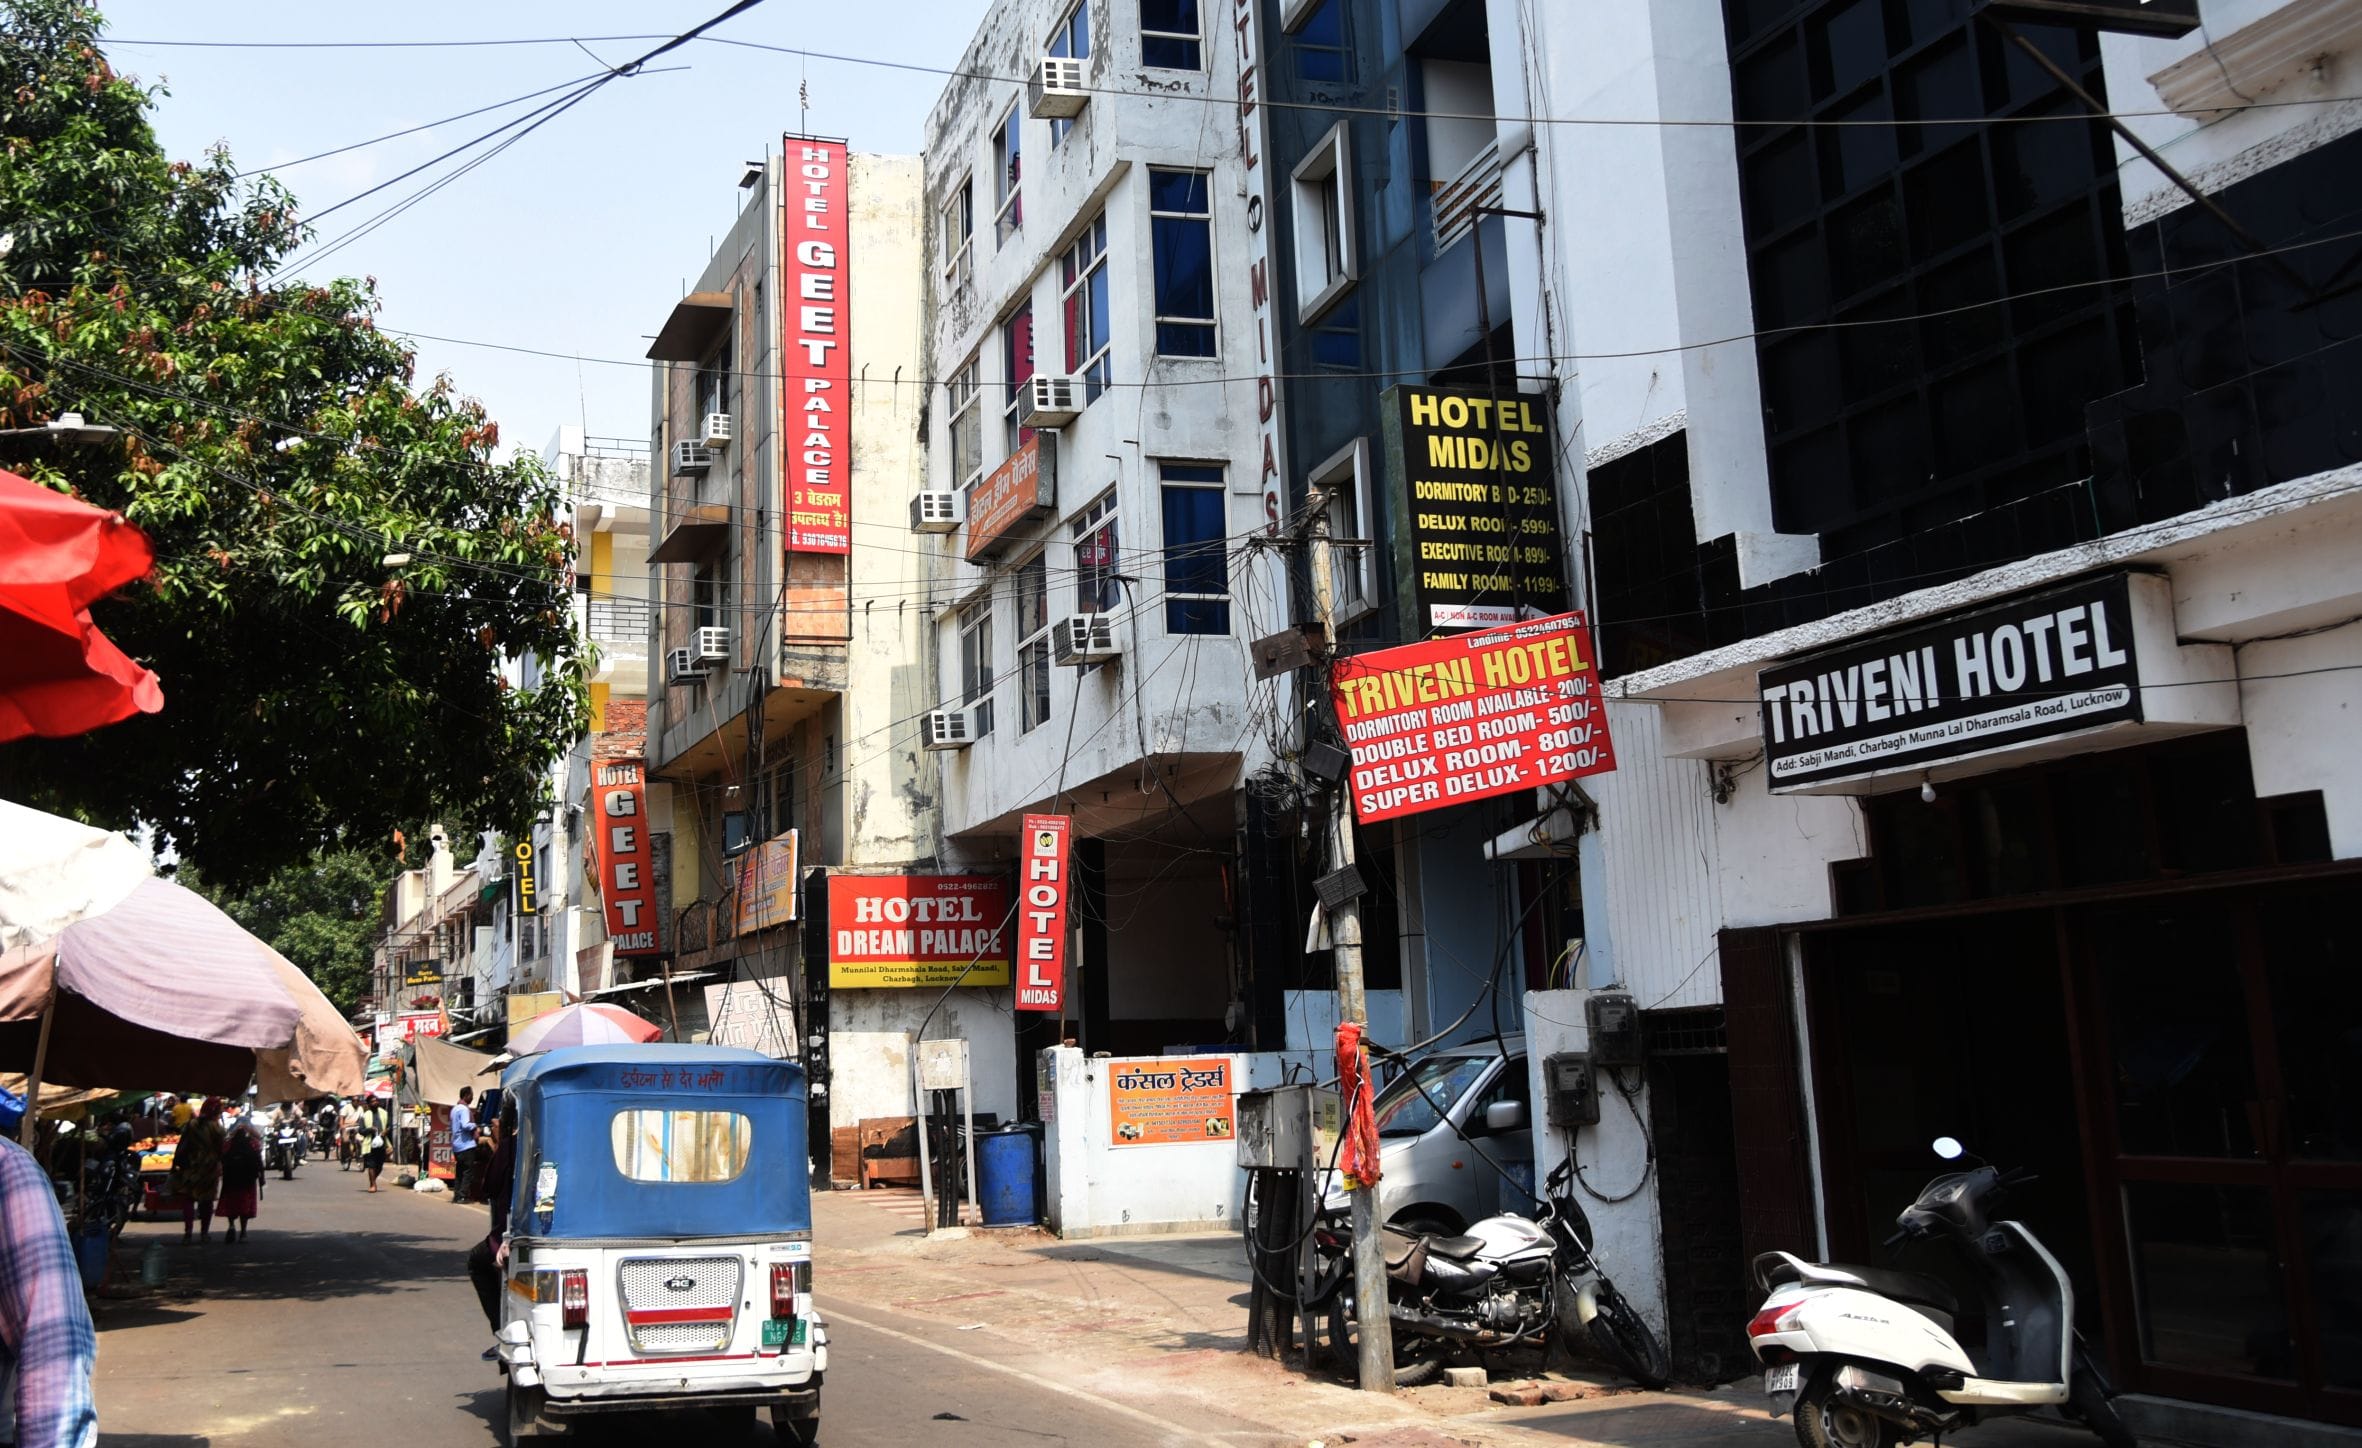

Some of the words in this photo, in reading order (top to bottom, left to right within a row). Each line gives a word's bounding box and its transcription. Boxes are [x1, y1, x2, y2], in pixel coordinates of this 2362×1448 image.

[801, 147, 829, 230] HOTEL
[797, 240, 836, 367] GEET
[1250, 257, 1279, 539] MIDAS
[1410, 394, 1543, 433] HOTEL
[803, 378, 832, 485] PALACE
[1428, 435, 1531, 473] MIDAS
[1415, 481, 1487, 502] DORMITORY
[1418, 513, 1467, 531] DELUX
[1420, 542, 1484, 562] EXECUTIVE
[1423, 572, 1468, 590] FAMILY
[1479, 612, 1499, 622] ROOM
[1338, 656, 1476, 718] TRIVENI
[1482, 634, 1590, 695] HOTEL
[1763, 646, 1940, 744] TRIVENI
[1953, 601, 2126, 701] HOTEL
[1346, 709, 1428, 743] DORMITORY
[1431, 702, 1474, 726] ROOM
[1557, 676, 1593, 701] 200/-
[1351, 733, 1429, 767] DOUBLE
[1434, 726, 1473, 747] BED
[1548, 702, 1598, 726] 500/-
[1776, 761, 1797, 773] Add:
[1799, 753, 1822, 768] Sabji
[1824, 746, 1857, 762] Mandi,
[1859, 735, 1907, 755] Charbagh
[1909, 730, 1945, 745] Munna
[1948, 722, 1963, 736] Lal
[1966, 709, 2032, 732] Dharamsala
[2034, 701, 2068, 717] Road,
[2070, 689, 2123, 710] Lucknow
[597, 764, 639, 786] HOTEL
[1356, 756, 1440, 791] DELUX
[1538, 727, 1603, 752] 800/-
[1361, 783, 1440, 814] SUPER
[1535, 747, 1608, 777] 1200/-
[516, 832, 536, 913] OTEL
[604, 790, 643, 926] GEET
[611, 932, 654, 950] PALACE
[837, 930, 915, 956] DREAM
[921, 928, 1001, 954] PALACE
[855, 897, 983, 923] HOTEL
[1028, 859, 1059, 986] HOTEL
[1021, 989, 1058, 1005] MIDAS
[1117, 1068, 1176, 1090] कंसल
[1179, 1064, 1225, 1092] ट्रेडर्स
